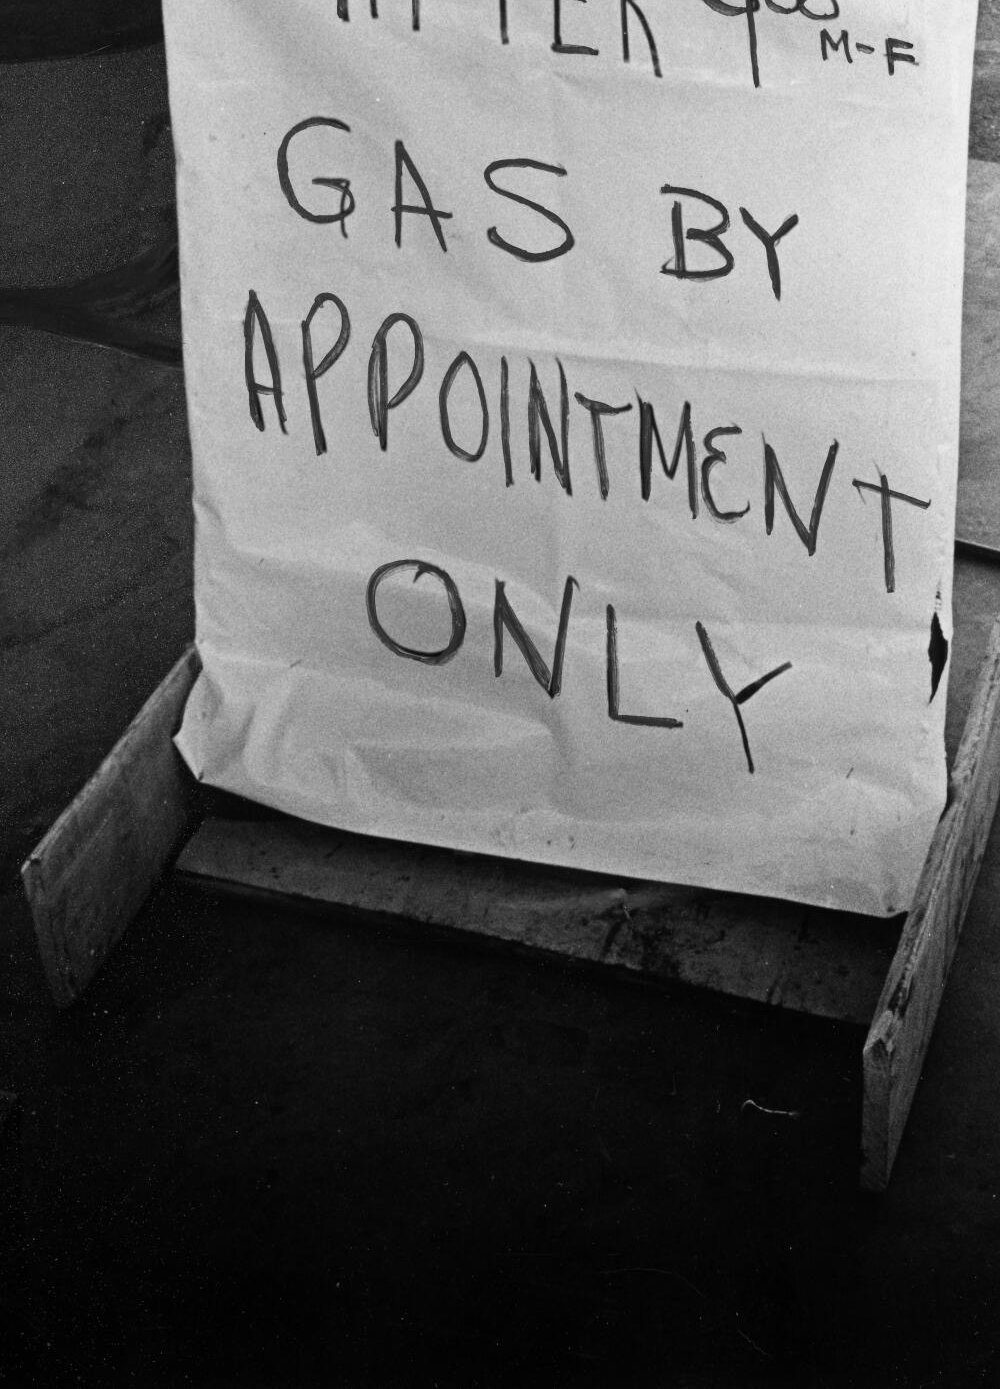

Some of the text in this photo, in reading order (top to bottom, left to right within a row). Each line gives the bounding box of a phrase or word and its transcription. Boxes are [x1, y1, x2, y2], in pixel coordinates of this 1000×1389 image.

[819, 28, 920, 77] M-F
[278, 116, 799, 302] GAS BY
[243, 289, 932, 594] APPOINTMENT
[366, 558, 793, 775] ONLY
